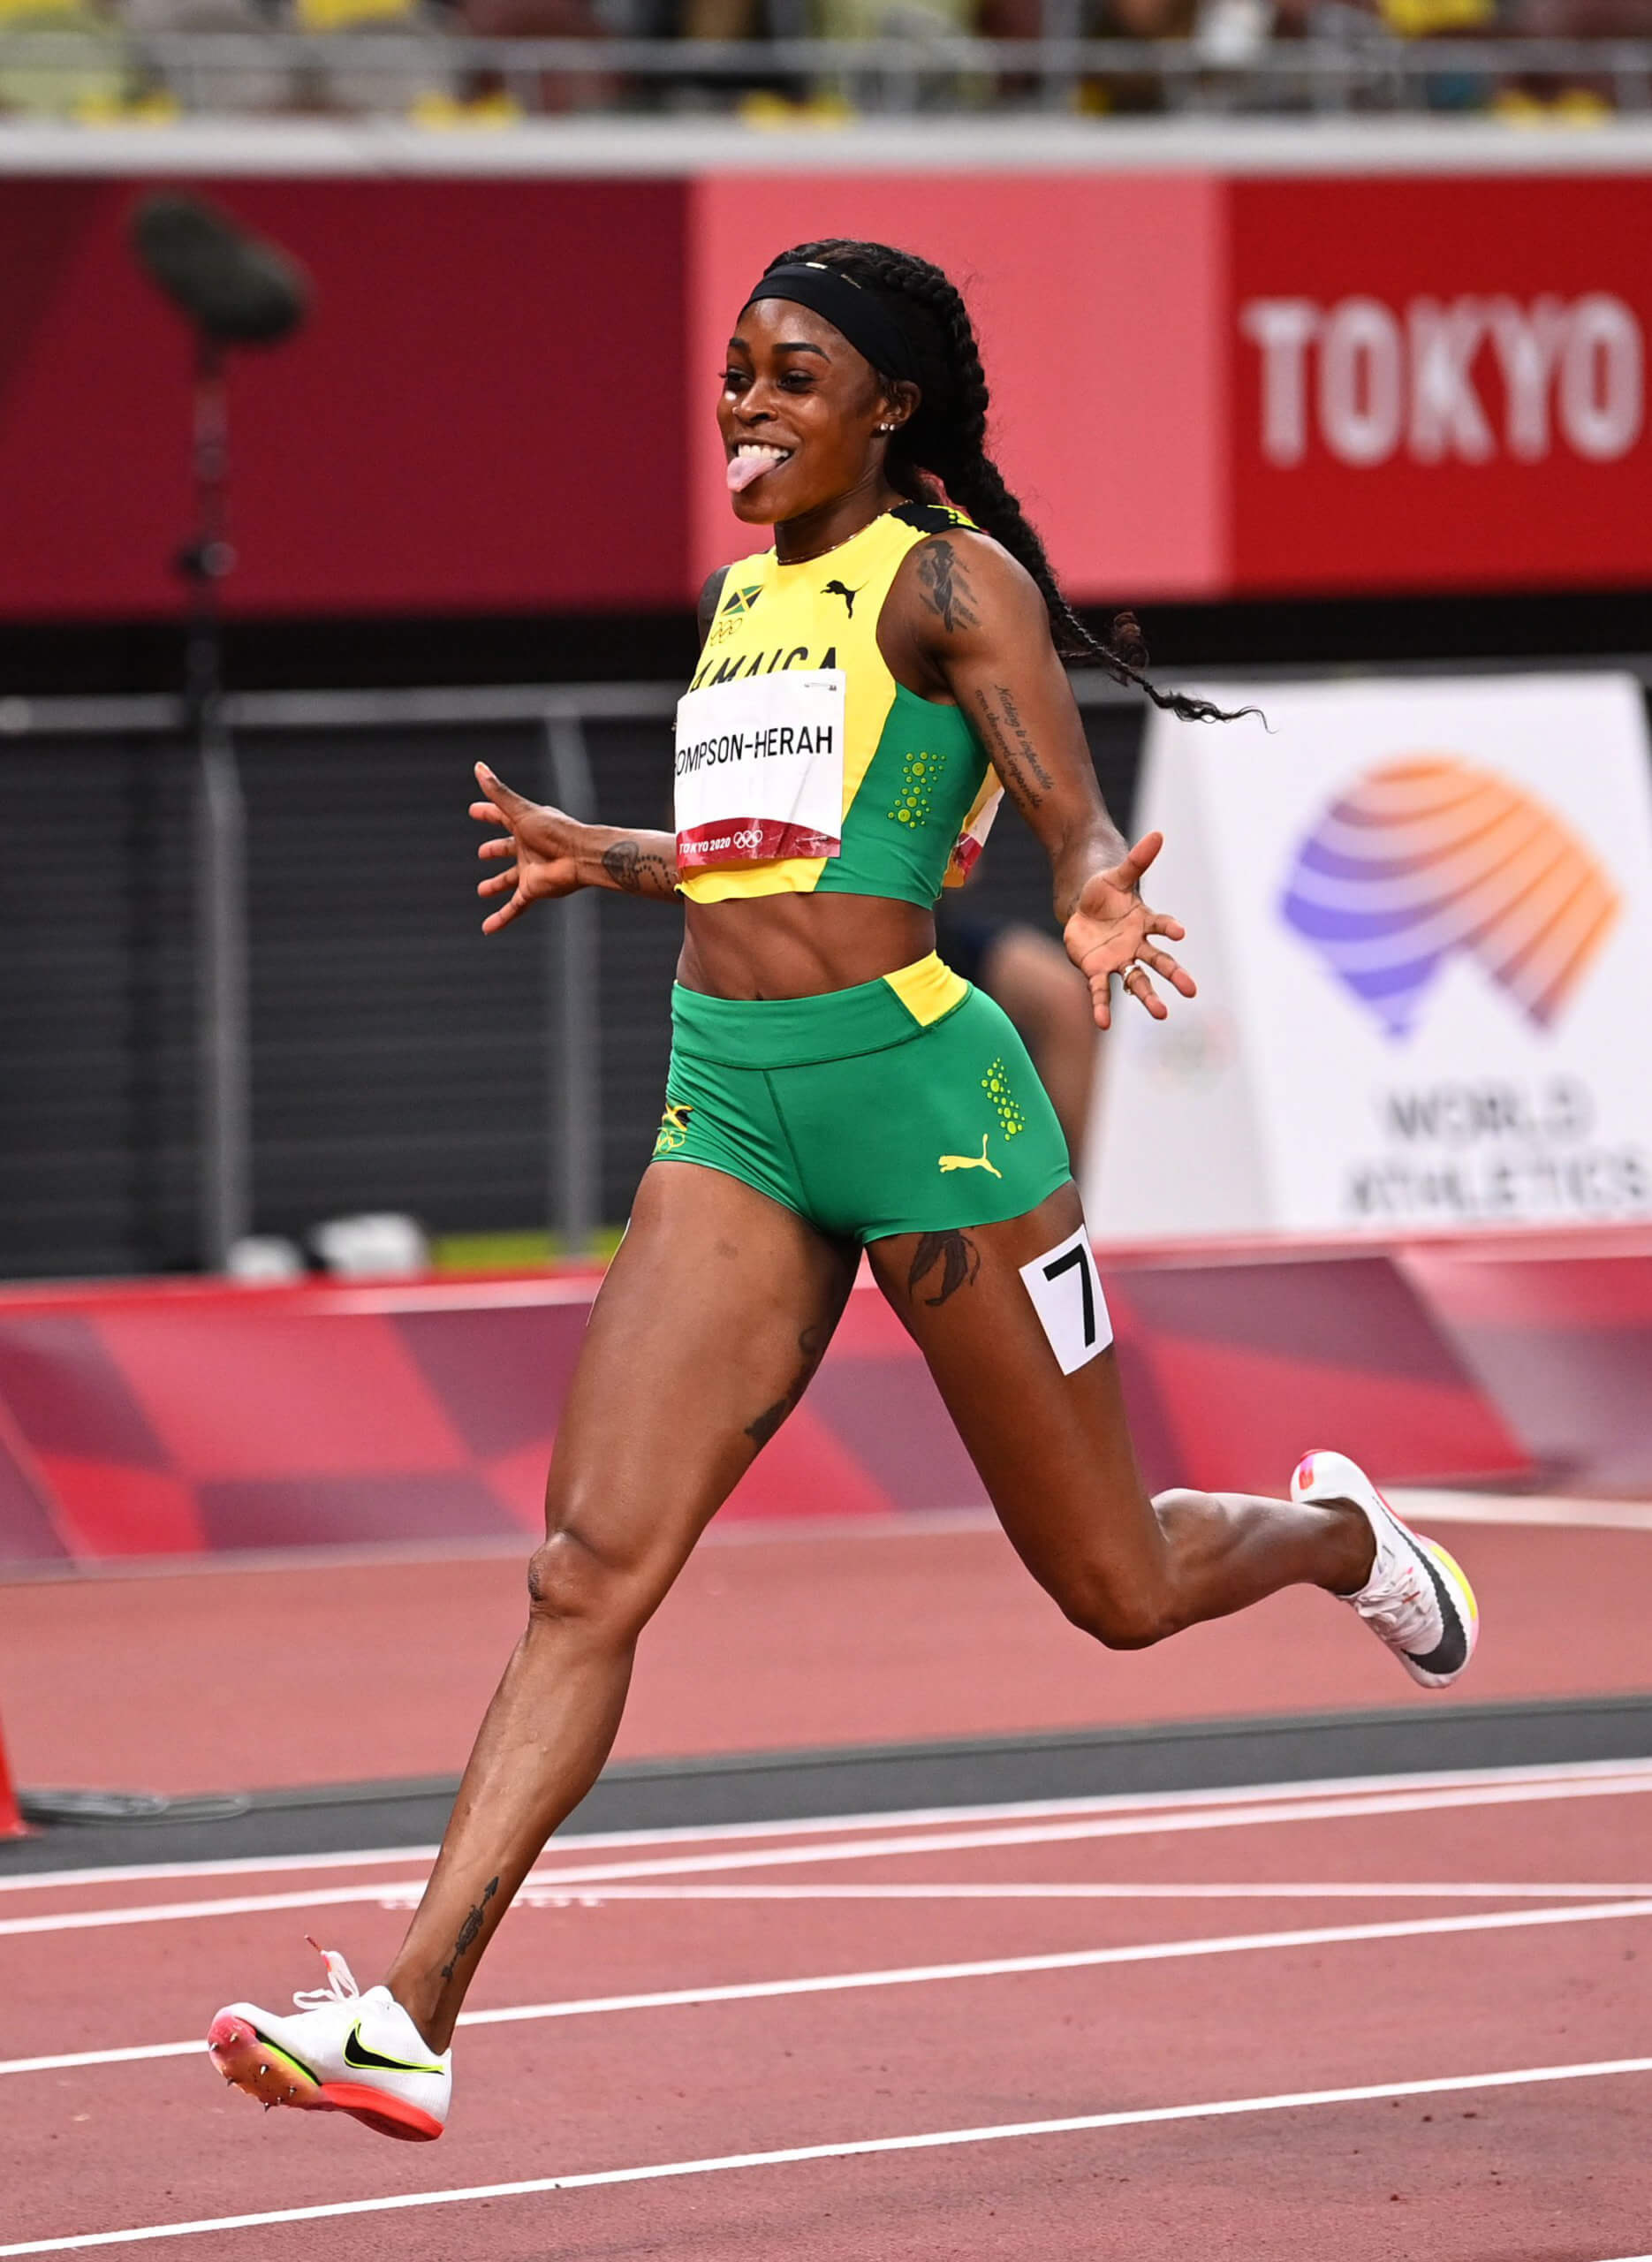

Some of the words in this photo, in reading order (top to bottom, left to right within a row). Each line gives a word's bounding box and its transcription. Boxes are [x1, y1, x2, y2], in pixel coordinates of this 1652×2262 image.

[1242, 293, 1643, 467] TOKYO
[690, 647, 836, 693] AMAICA
[676, 725, 832, 776] OMPSON-HERAH
[679, 840, 709, 855] TOKYO
[709, 837, 731, 851] 2020
[1380, 1074, 1595, 1143] WORLD
[1042, 1243, 1095, 1348] 7
